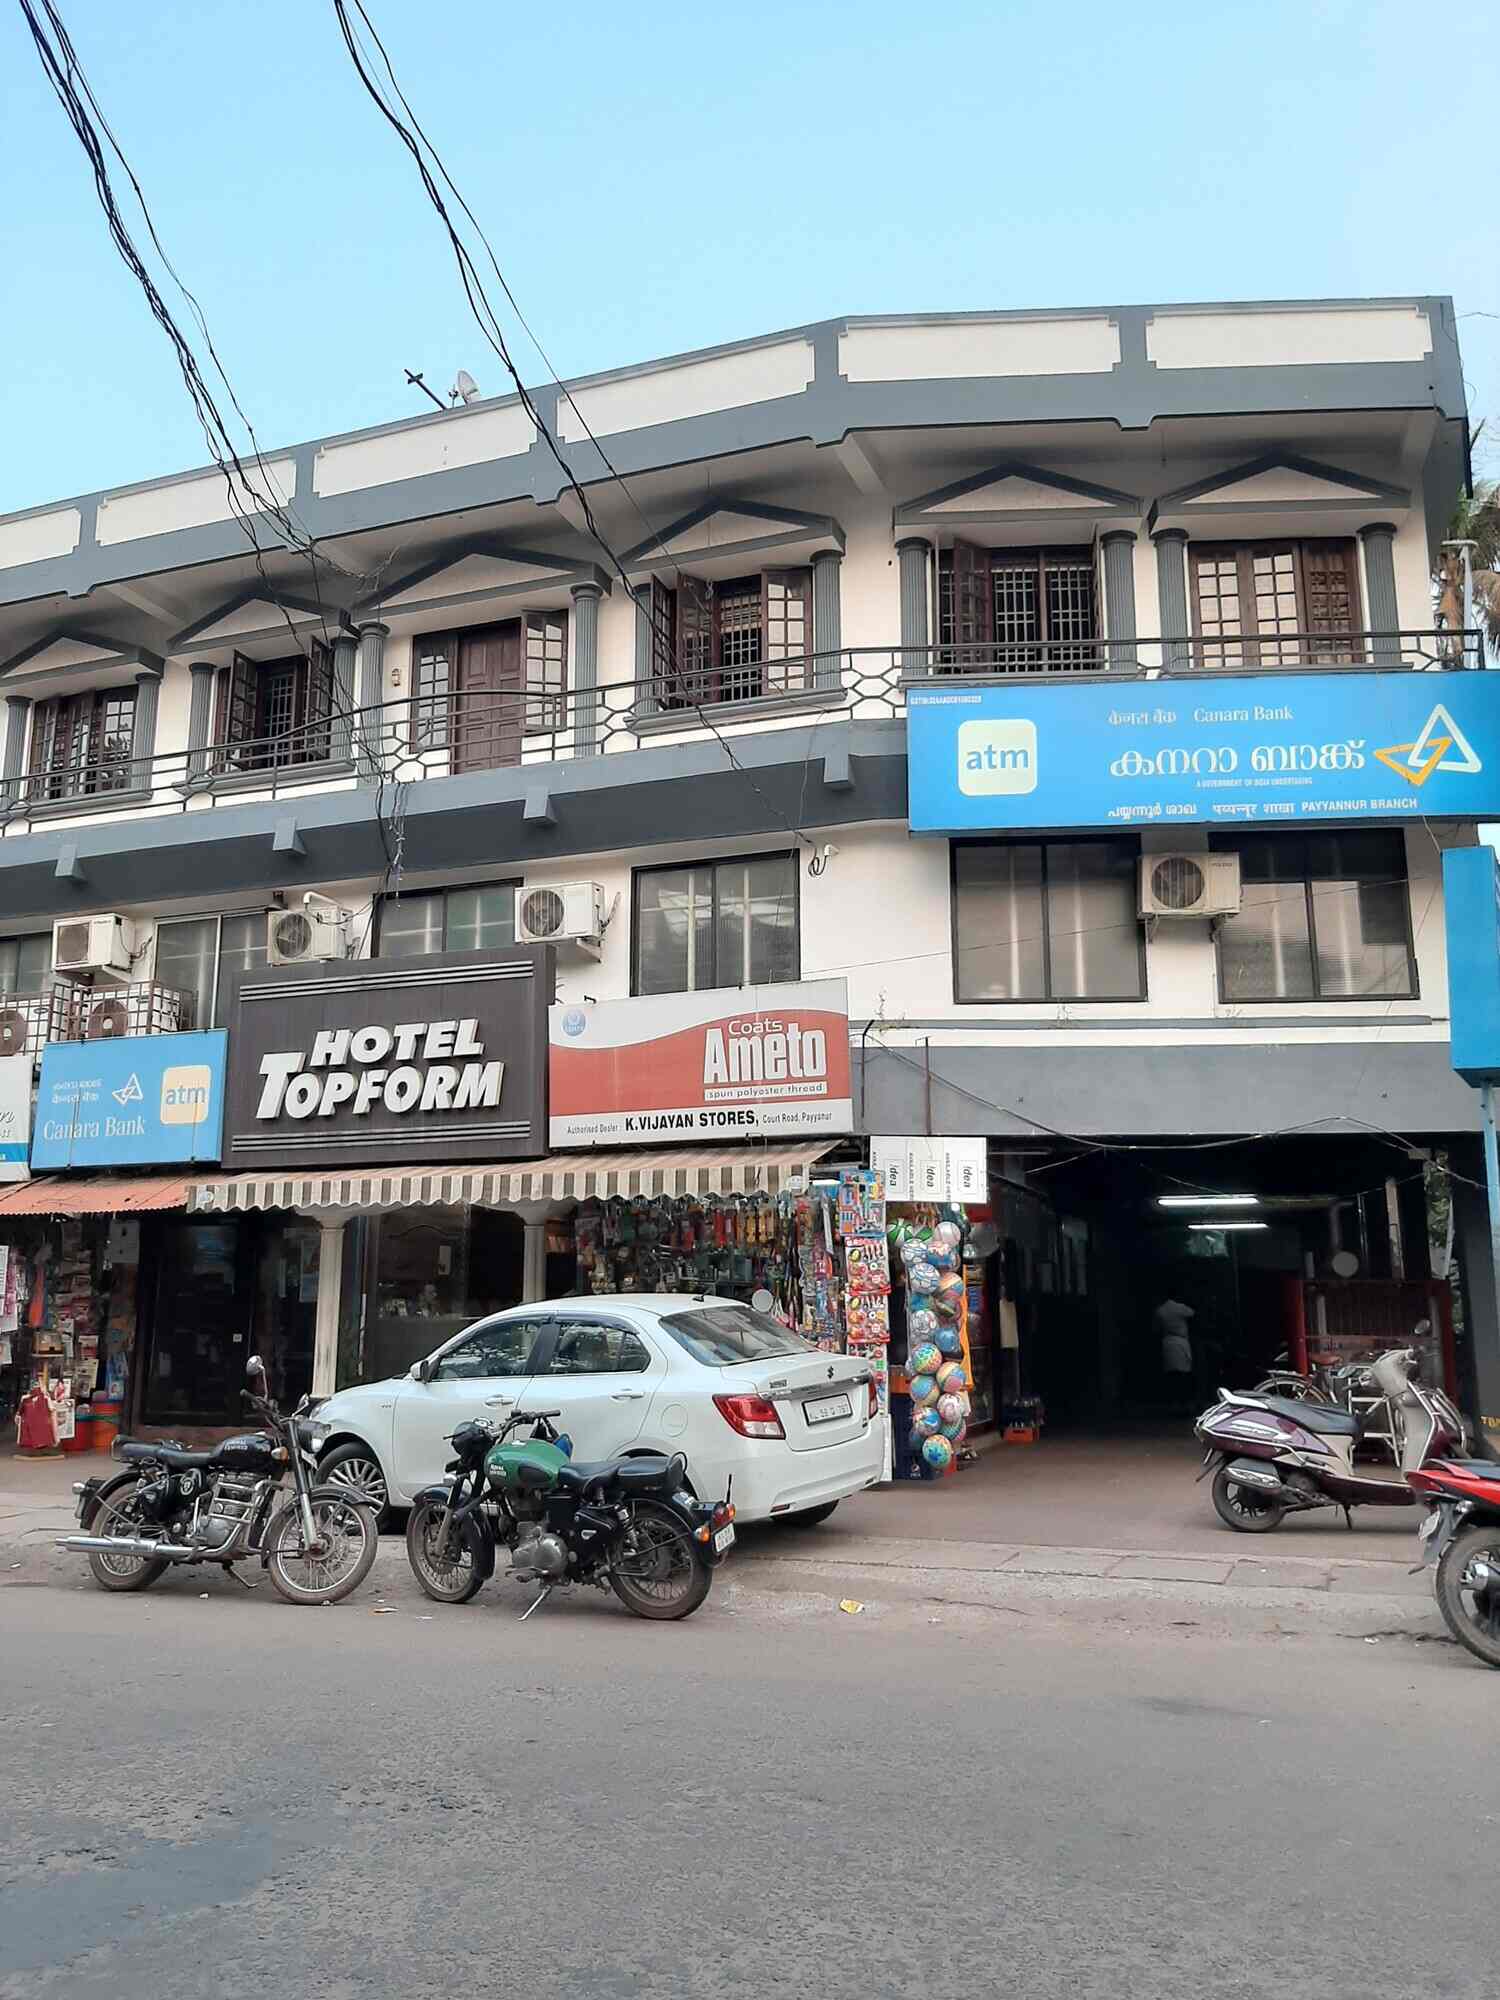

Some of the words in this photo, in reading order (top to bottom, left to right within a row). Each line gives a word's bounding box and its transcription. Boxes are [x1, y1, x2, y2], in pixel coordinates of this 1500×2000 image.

[1194, 707, 1249, 723] Canara
[1254, 704, 1294, 721] Bank
[966, 744, 1029, 770] atm
[1110, 746, 1238, 777] കനറാ
[1251, 739, 1367, 772] ബാങ്ക്
[1302, 799, 1367, 813] PAYYANNUR
[1370, 798, 1417, 809] BRANCH
[728, 1018, 783, 1035] Coats
[310, 1018, 484, 1067] HOTEL
[703, 1022, 827, 1084] Ameto
[166, 1086, 207, 1105] atm
[256, 1051, 505, 1119] TOPFORM
[709, 1090, 733, 1099] spun
[736, 1087, 784, 1098] polyester
[788, 1083, 823, 1094] thread
[43, 1118, 100, 1140] Canara
[105, 1114, 146, 1137] Bank
[625, 1112, 694, 1131] K.VIJAYAN
[700, 1110, 759, 1127] STORES,
[762, 1114, 781, 1124] Court
